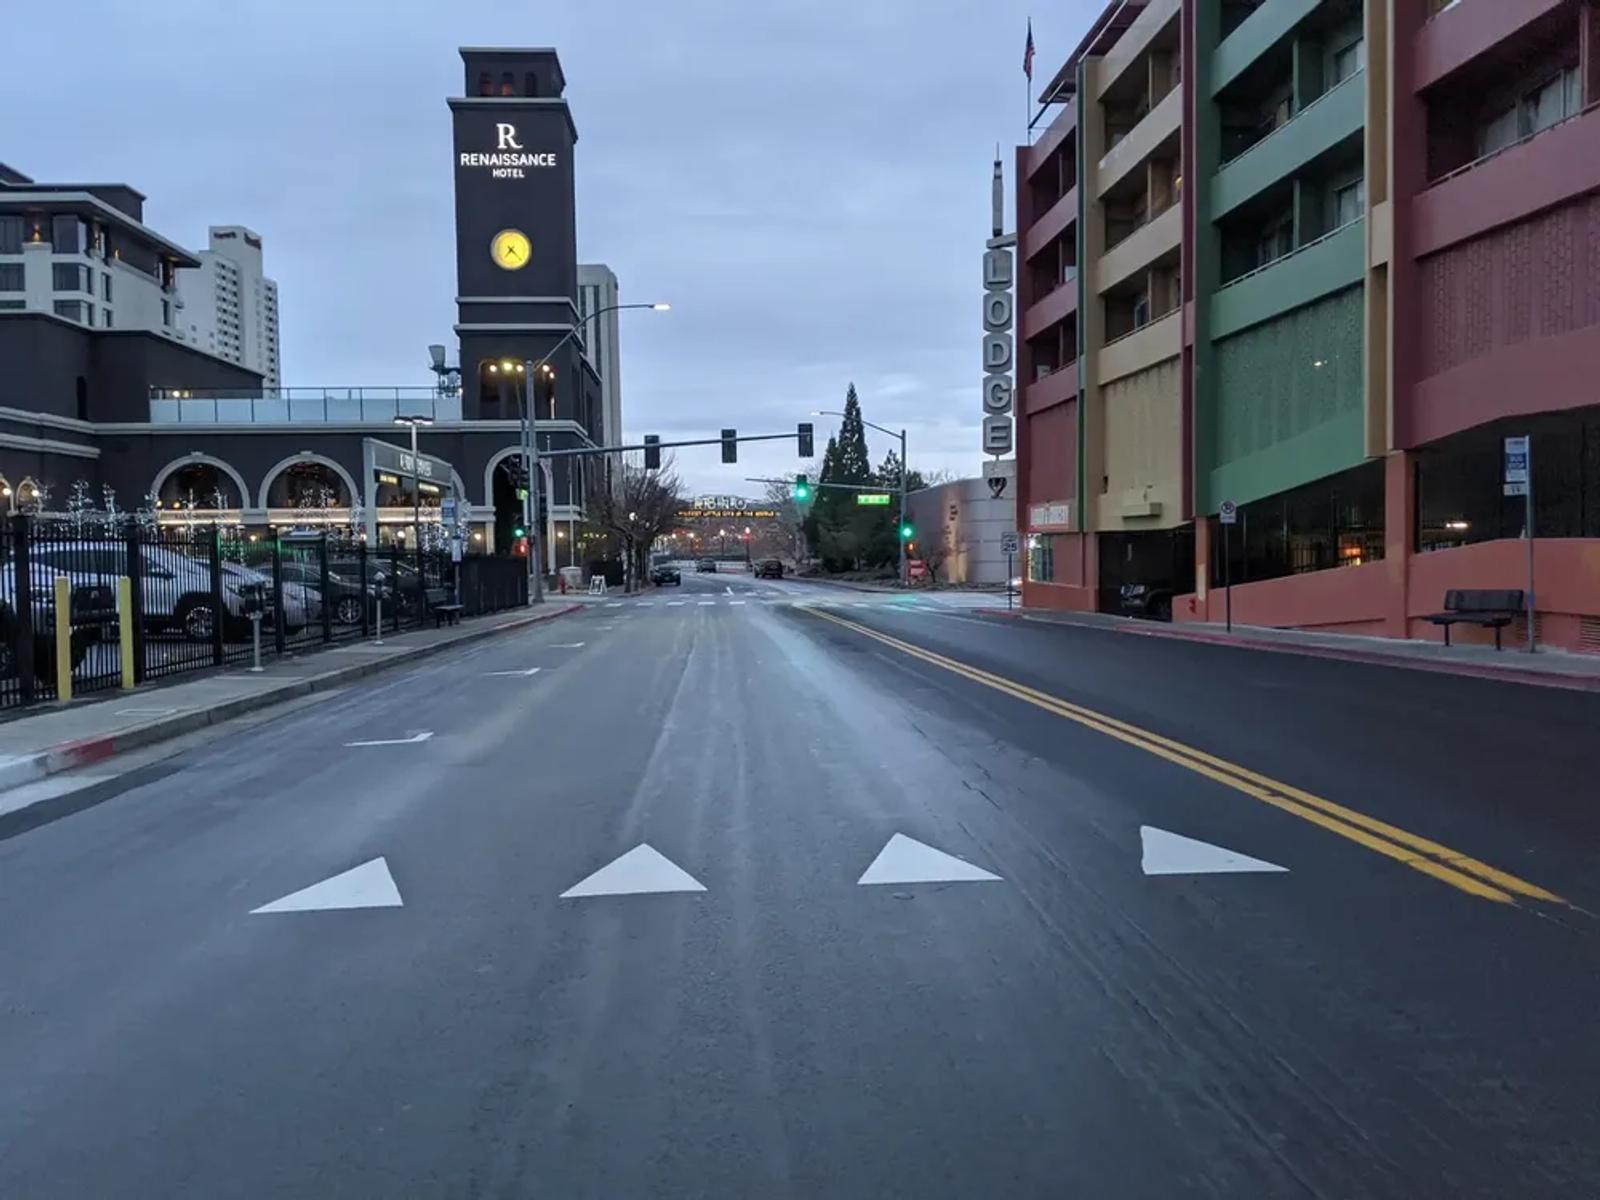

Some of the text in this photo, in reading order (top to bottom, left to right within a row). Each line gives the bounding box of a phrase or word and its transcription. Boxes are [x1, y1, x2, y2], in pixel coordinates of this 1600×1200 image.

[496, 123, 523, 149] R
[460, 153, 556, 166] RENAISSANCE
[492, 168, 525, 178] HOTEL
[985, 254, 1012, 449] LODGE
[1001, 542, 1017, 552] 25
